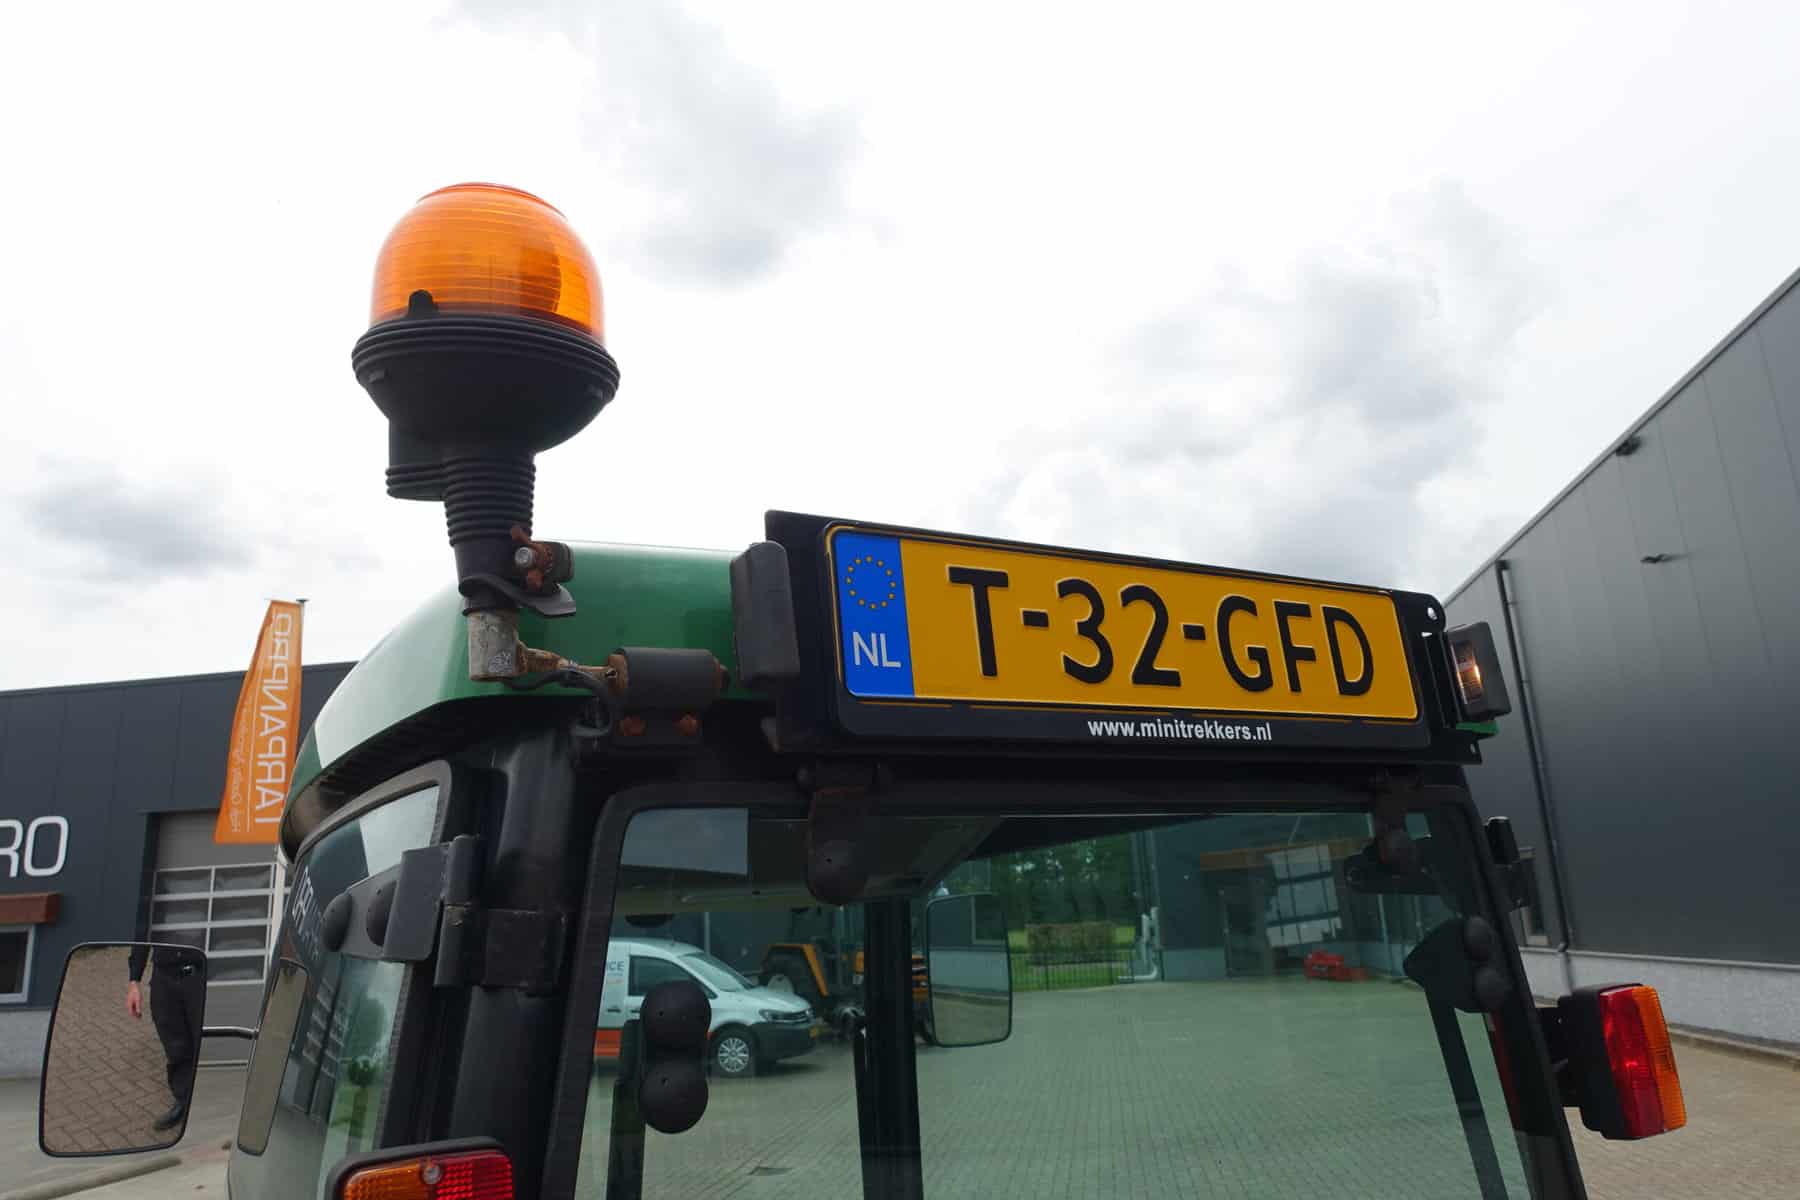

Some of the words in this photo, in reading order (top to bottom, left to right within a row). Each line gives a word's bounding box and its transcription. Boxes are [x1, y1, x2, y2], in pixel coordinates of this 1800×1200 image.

[852, 631, 902, 668] NL
[948, 566, 1374, 696] T-32-GFD
[1087, 718, 1273, 741] www.minitrekkers.nl
